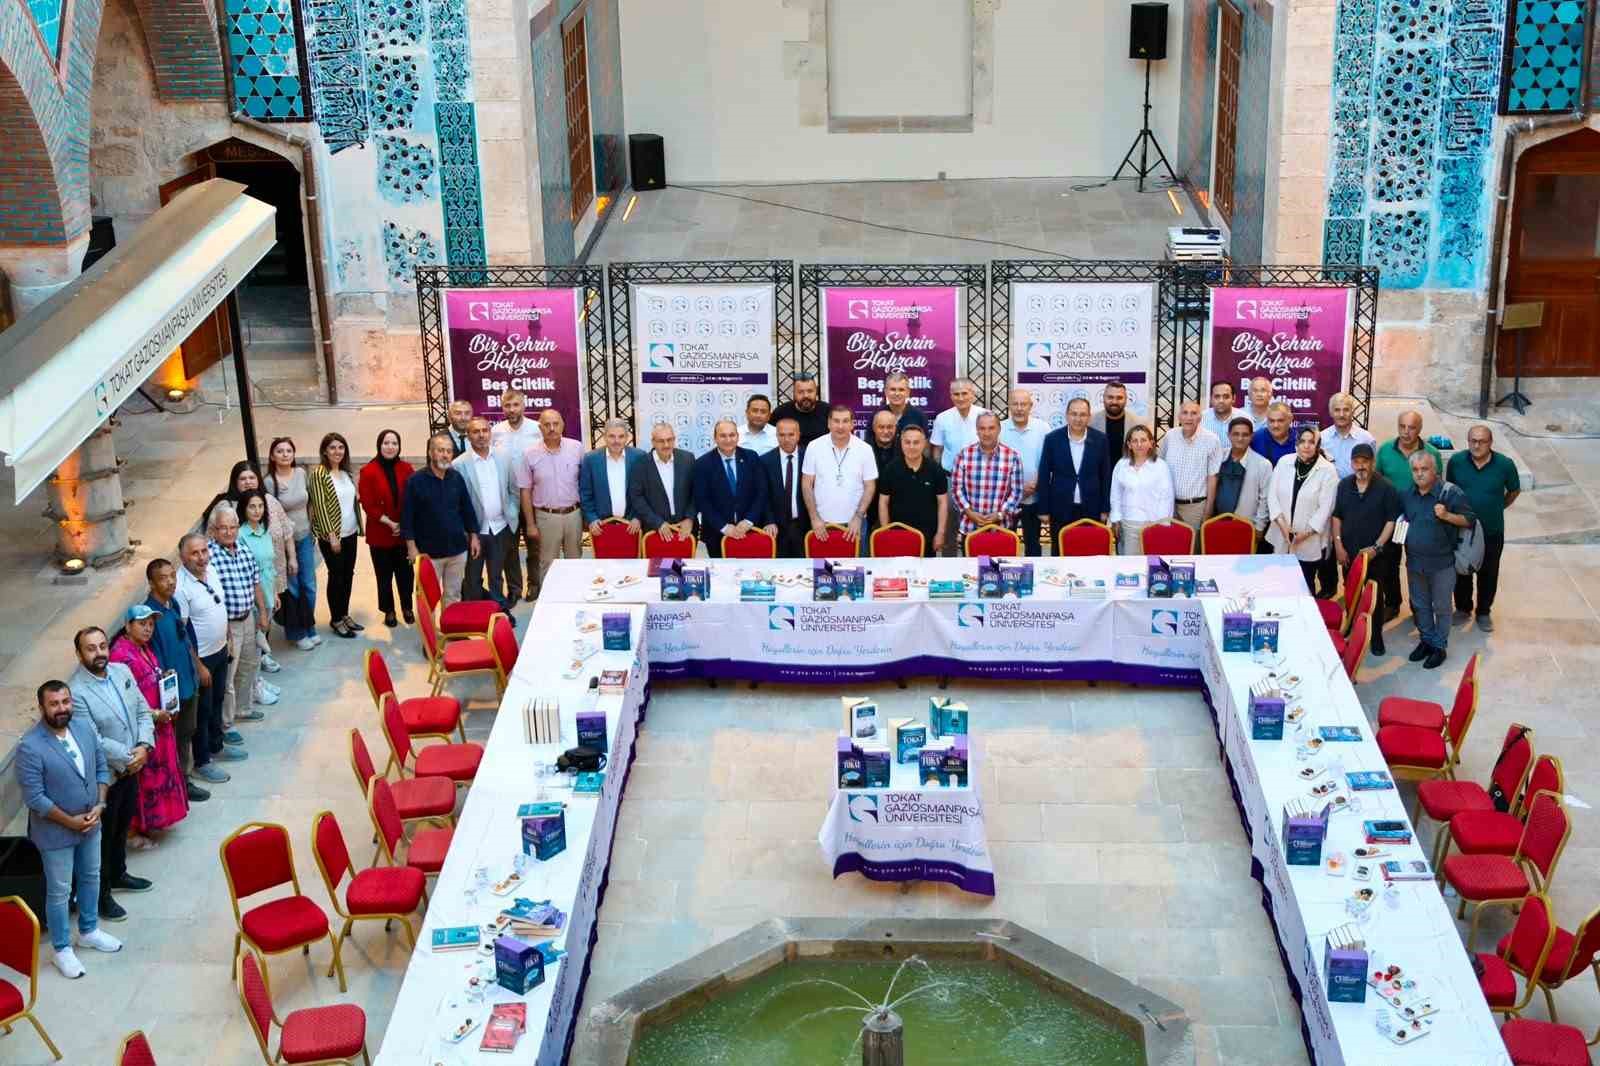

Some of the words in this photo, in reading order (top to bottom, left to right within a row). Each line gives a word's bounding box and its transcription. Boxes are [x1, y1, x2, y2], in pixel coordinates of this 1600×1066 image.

[468, 334, 499, 354] Bir
[679, 343, 709, 351] TOKAT
[846, 332, 877, 352] Bir
[1057, 342, 1086, 350] TOKAT
[1232, 332, 1264, 352] Bir
[110, 358, 134, 392] TOKAT
[482, 378, 509, 391] Beş
[511, 378, 555, 390] Ciltlik
[858, 377, 884, 391] Beş
[1272, 378, 1317, 391] Ciltlik
[487, 395, 501, 408] Bi
[525, 395, 552, 407] iras
[863, 395, 881, 406] Bir
[800, 606, 832, 614] TOKAT
[991, 603, 1021, 611] TOKAT
[903, 736, 923, 744] TOKAT
[885, 793, 922, 803] TOKAT
